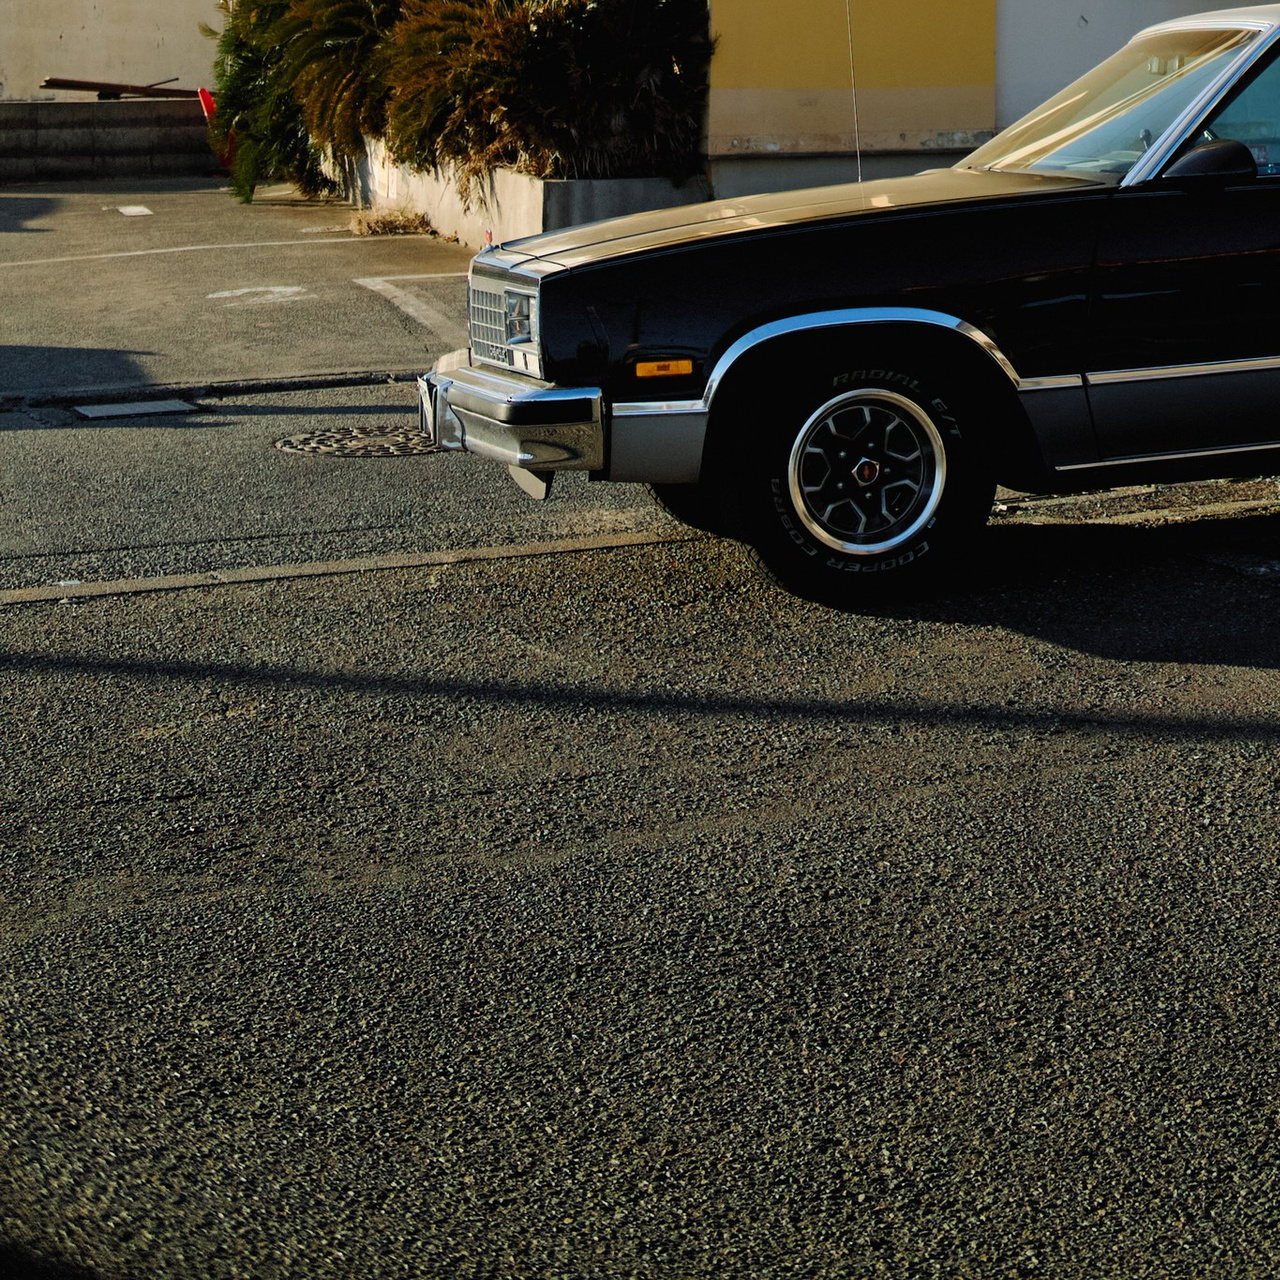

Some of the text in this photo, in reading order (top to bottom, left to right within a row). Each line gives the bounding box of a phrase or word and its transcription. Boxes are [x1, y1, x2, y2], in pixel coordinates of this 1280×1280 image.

[831, 368, 963, 440] RADIAL G/T
[771, 477, 930, 573] COOPER COBRA
